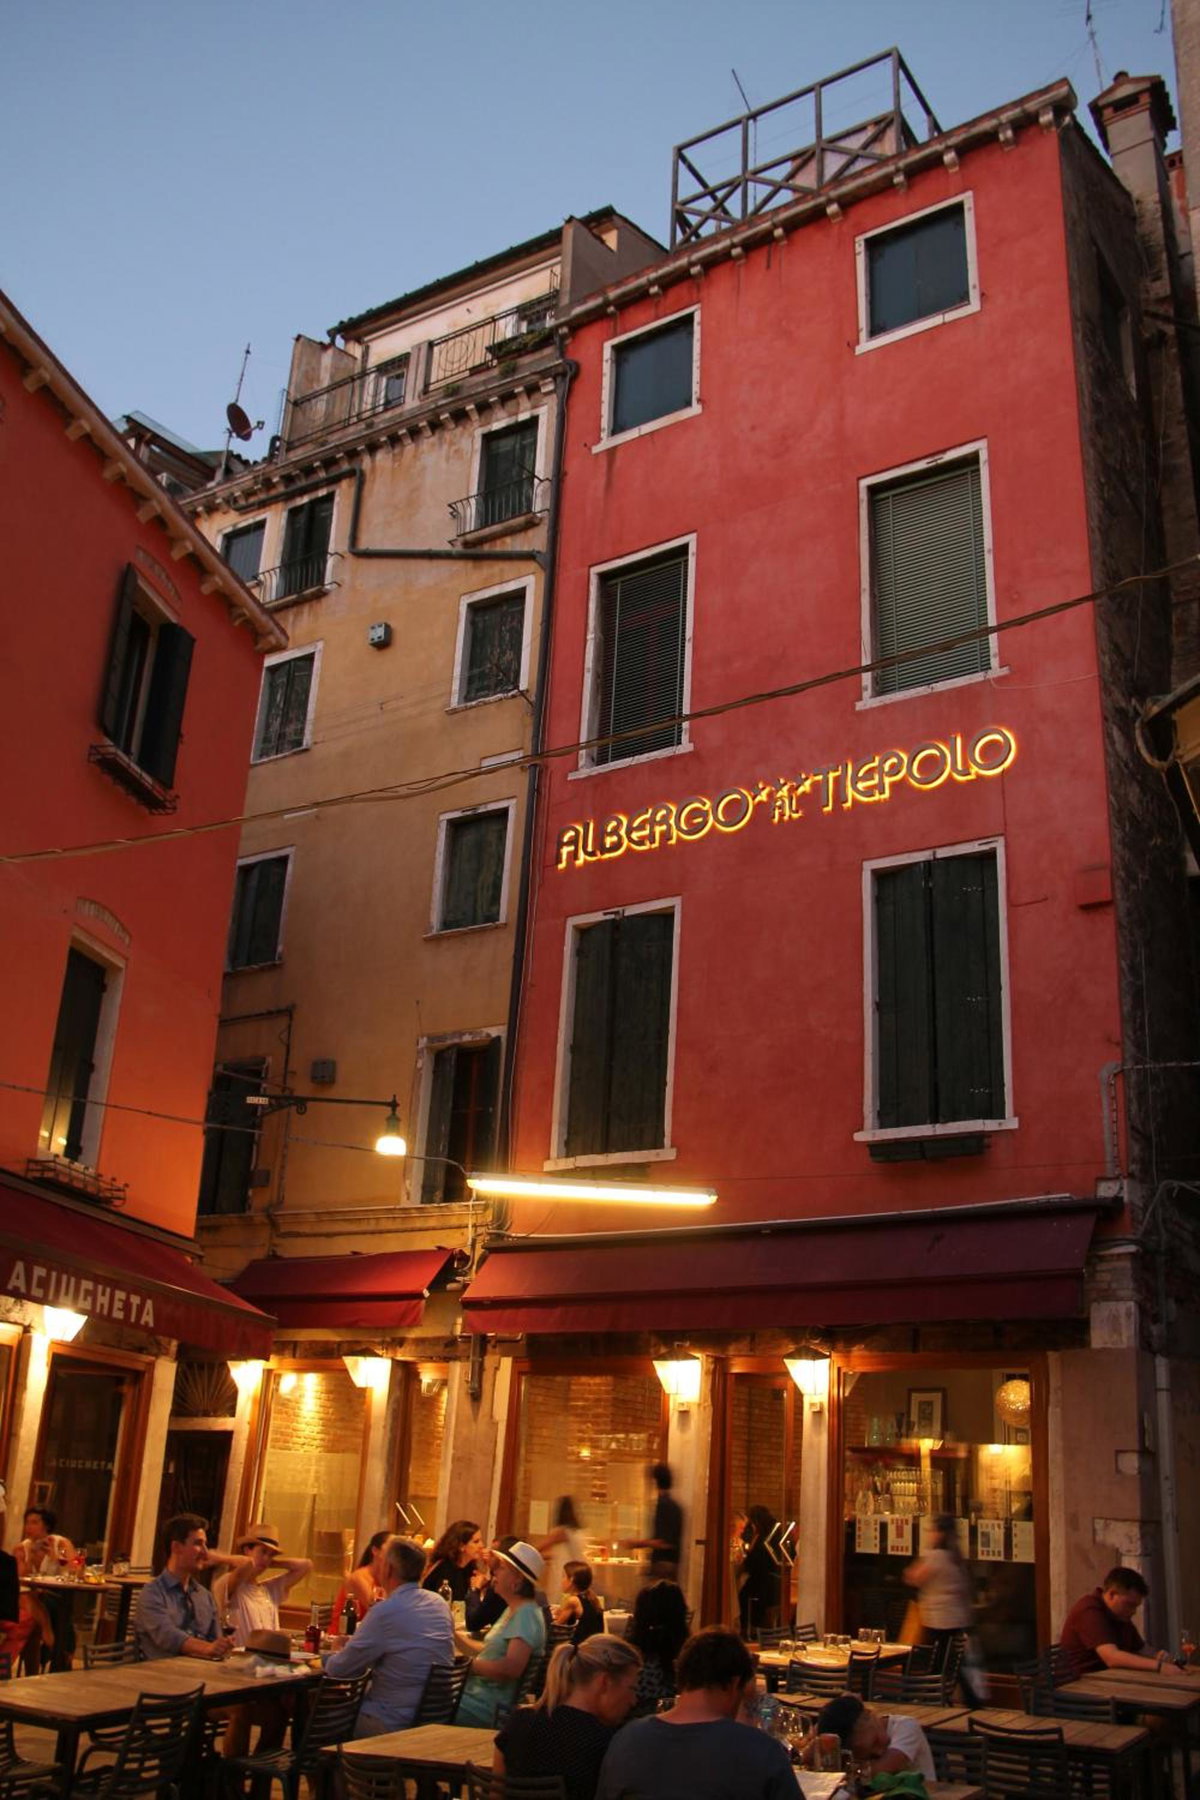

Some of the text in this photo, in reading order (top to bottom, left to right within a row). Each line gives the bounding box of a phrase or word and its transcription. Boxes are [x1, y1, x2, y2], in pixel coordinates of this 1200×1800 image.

[556, 726, 1016, 869] ALBERGO AL TIEPOLO
[6, 1260, 155, 1328] ACIUGHETA
